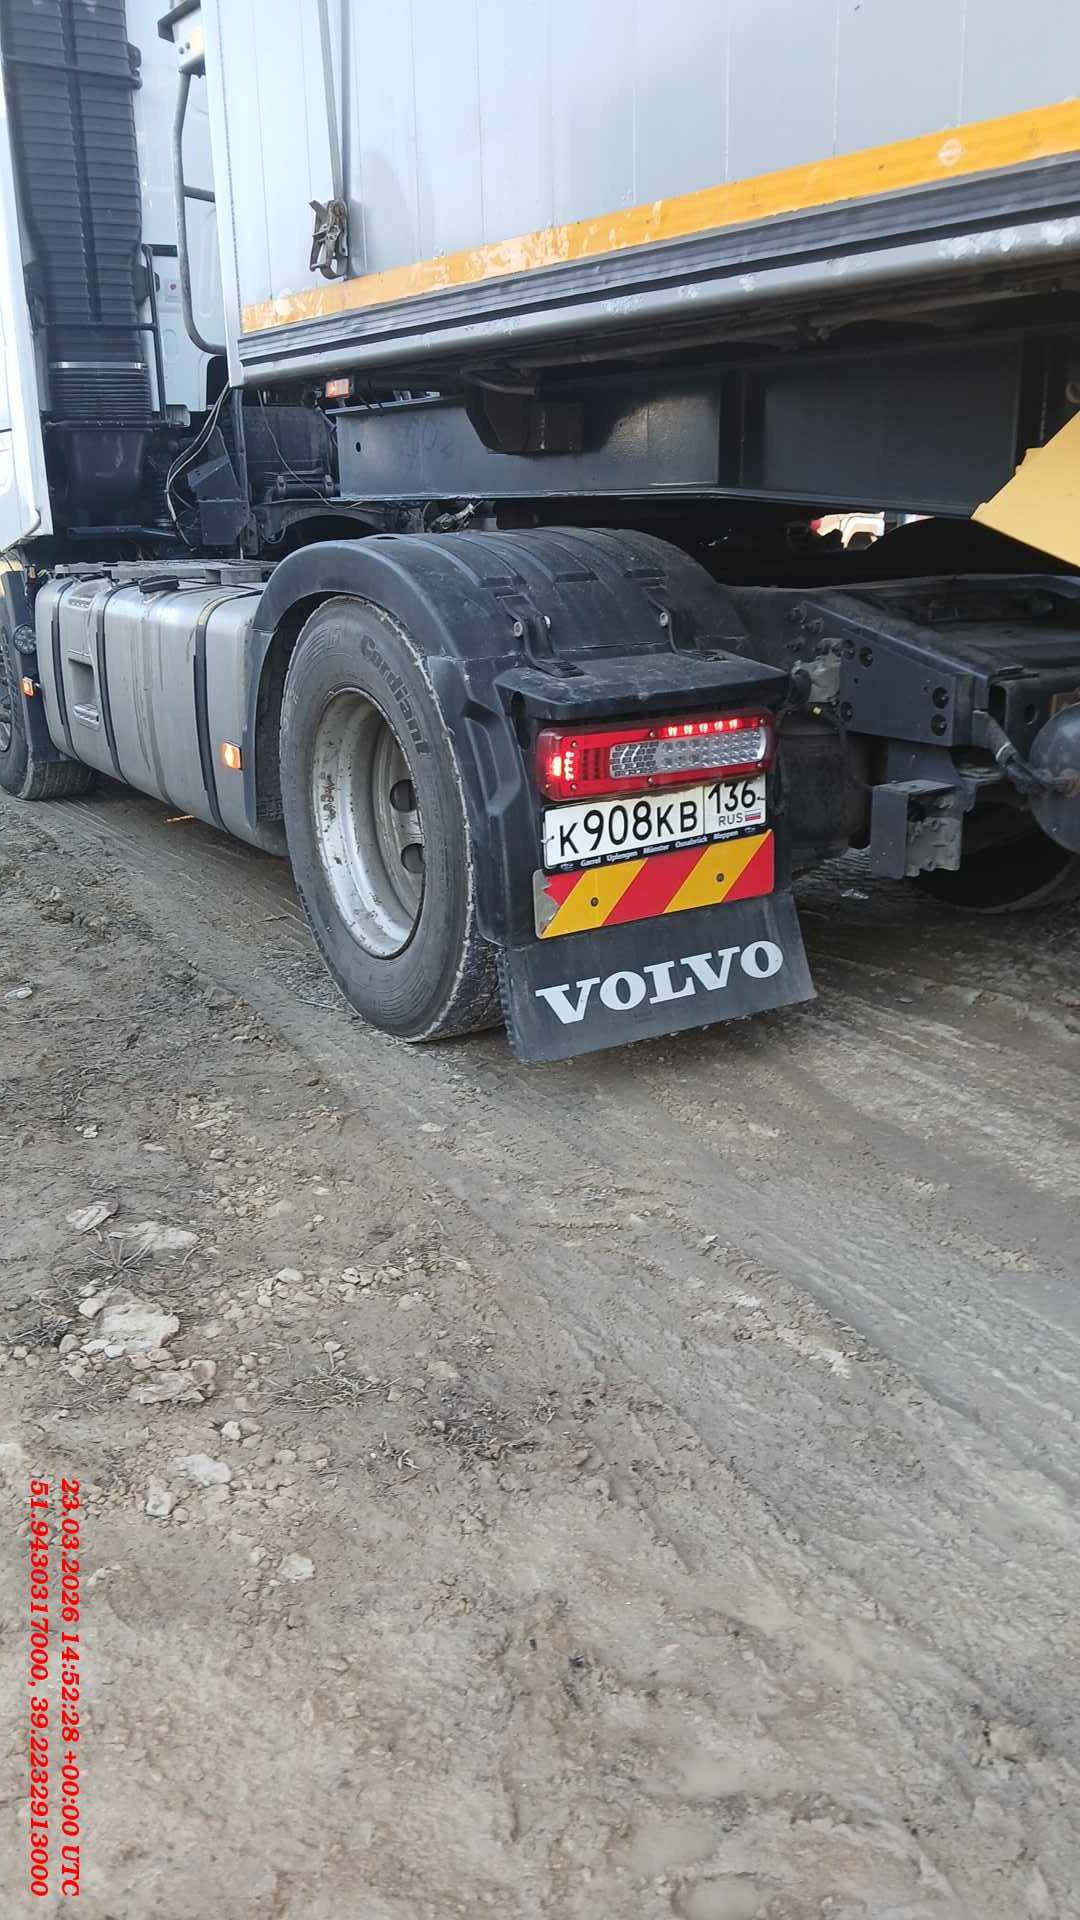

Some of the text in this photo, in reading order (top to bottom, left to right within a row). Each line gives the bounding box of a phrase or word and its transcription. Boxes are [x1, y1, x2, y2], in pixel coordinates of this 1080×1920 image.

[708, 782, 756, 814] 136
[718, 813, 743, 826] RUS
[535, 940, 784, 1024] VOLVO
